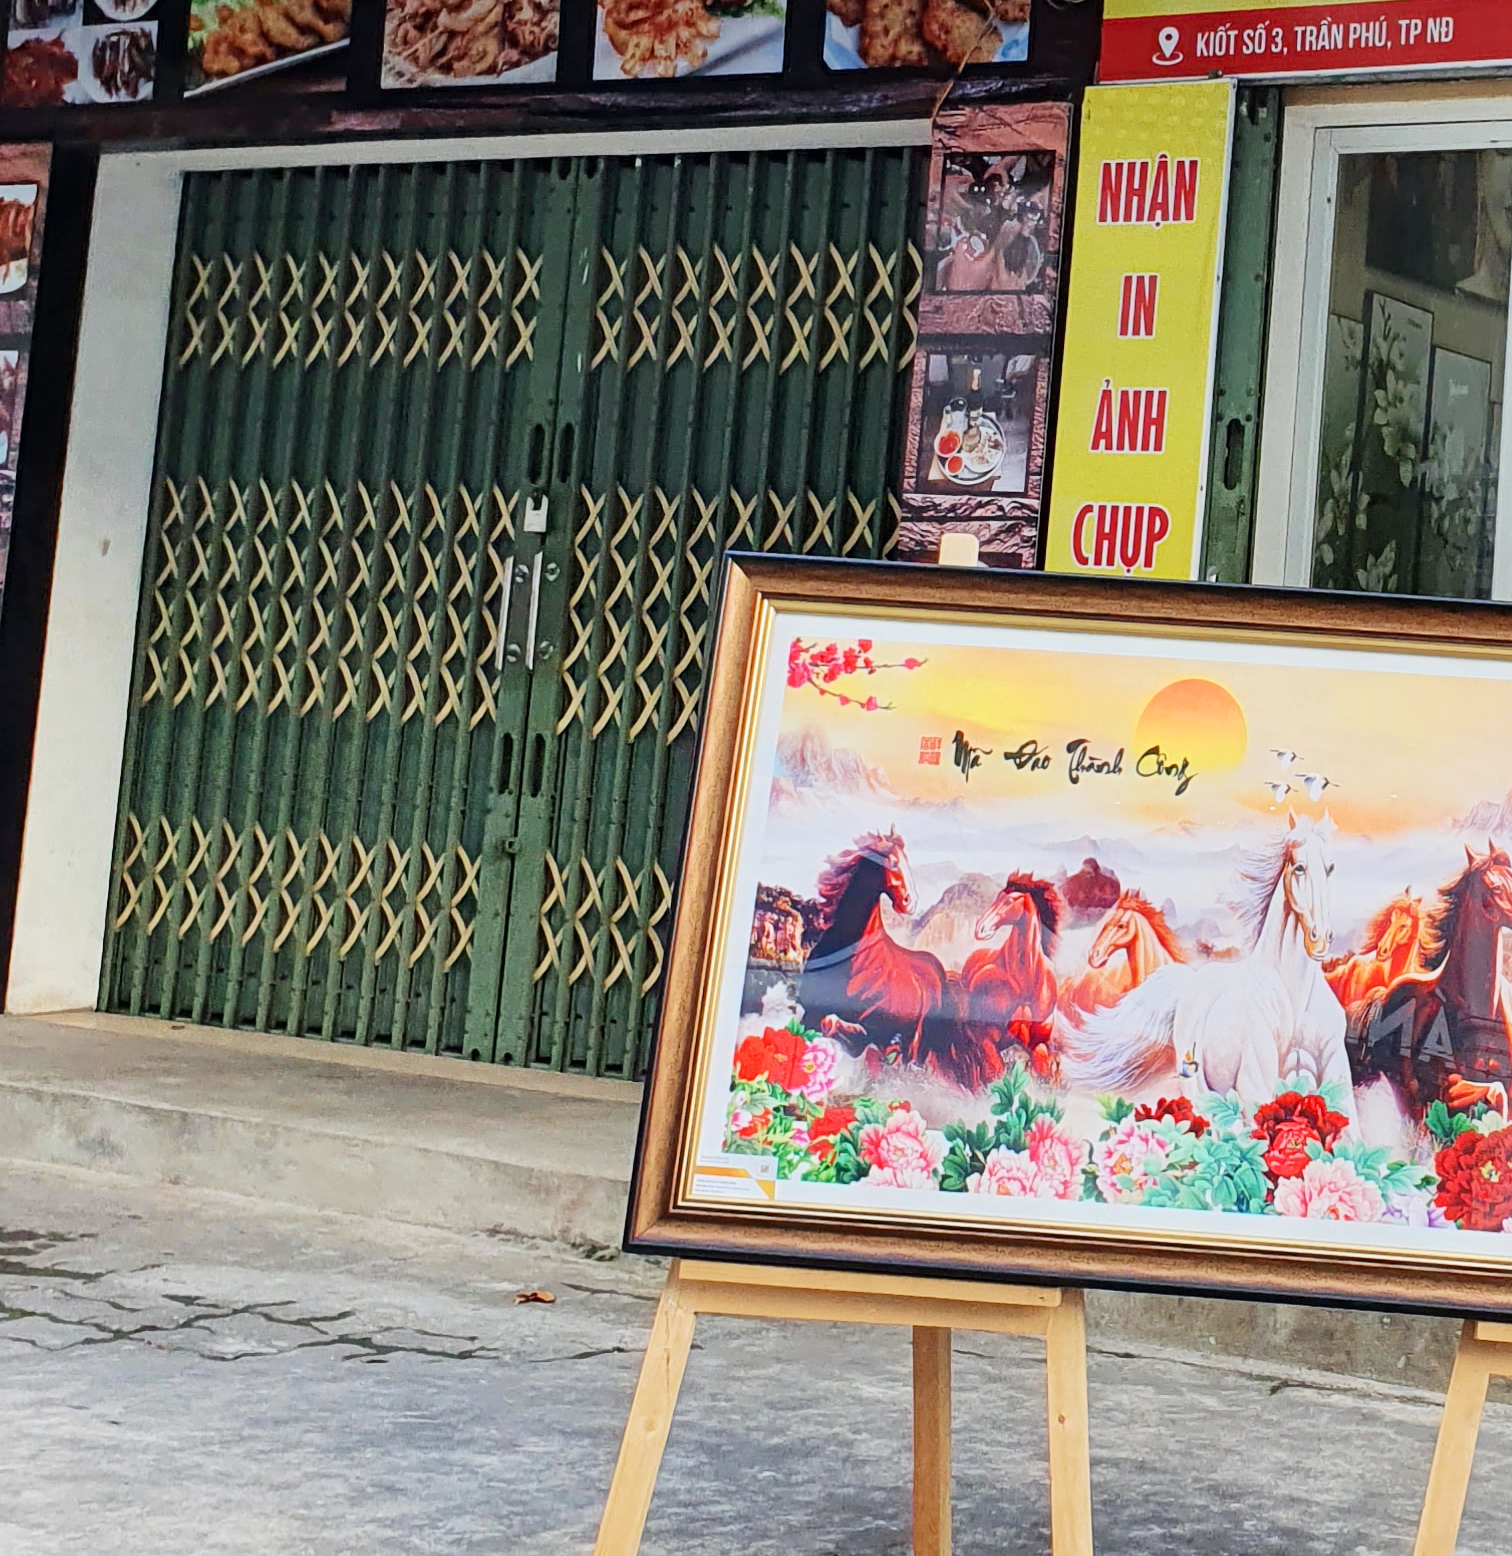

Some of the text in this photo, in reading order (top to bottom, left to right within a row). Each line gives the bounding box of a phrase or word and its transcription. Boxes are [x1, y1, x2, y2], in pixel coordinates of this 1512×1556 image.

[1196, 14, 1455, 58] KIỐT SỐ 3, TRẦN PHÚ, TP NĐ
[1100, 154, 1199, 226] NHẬN
[1119, 274, 1157, 338] IN
[1090, 378, 1167, 453] ẢNH
[1072, 503, 1169, 573] CHỤP
